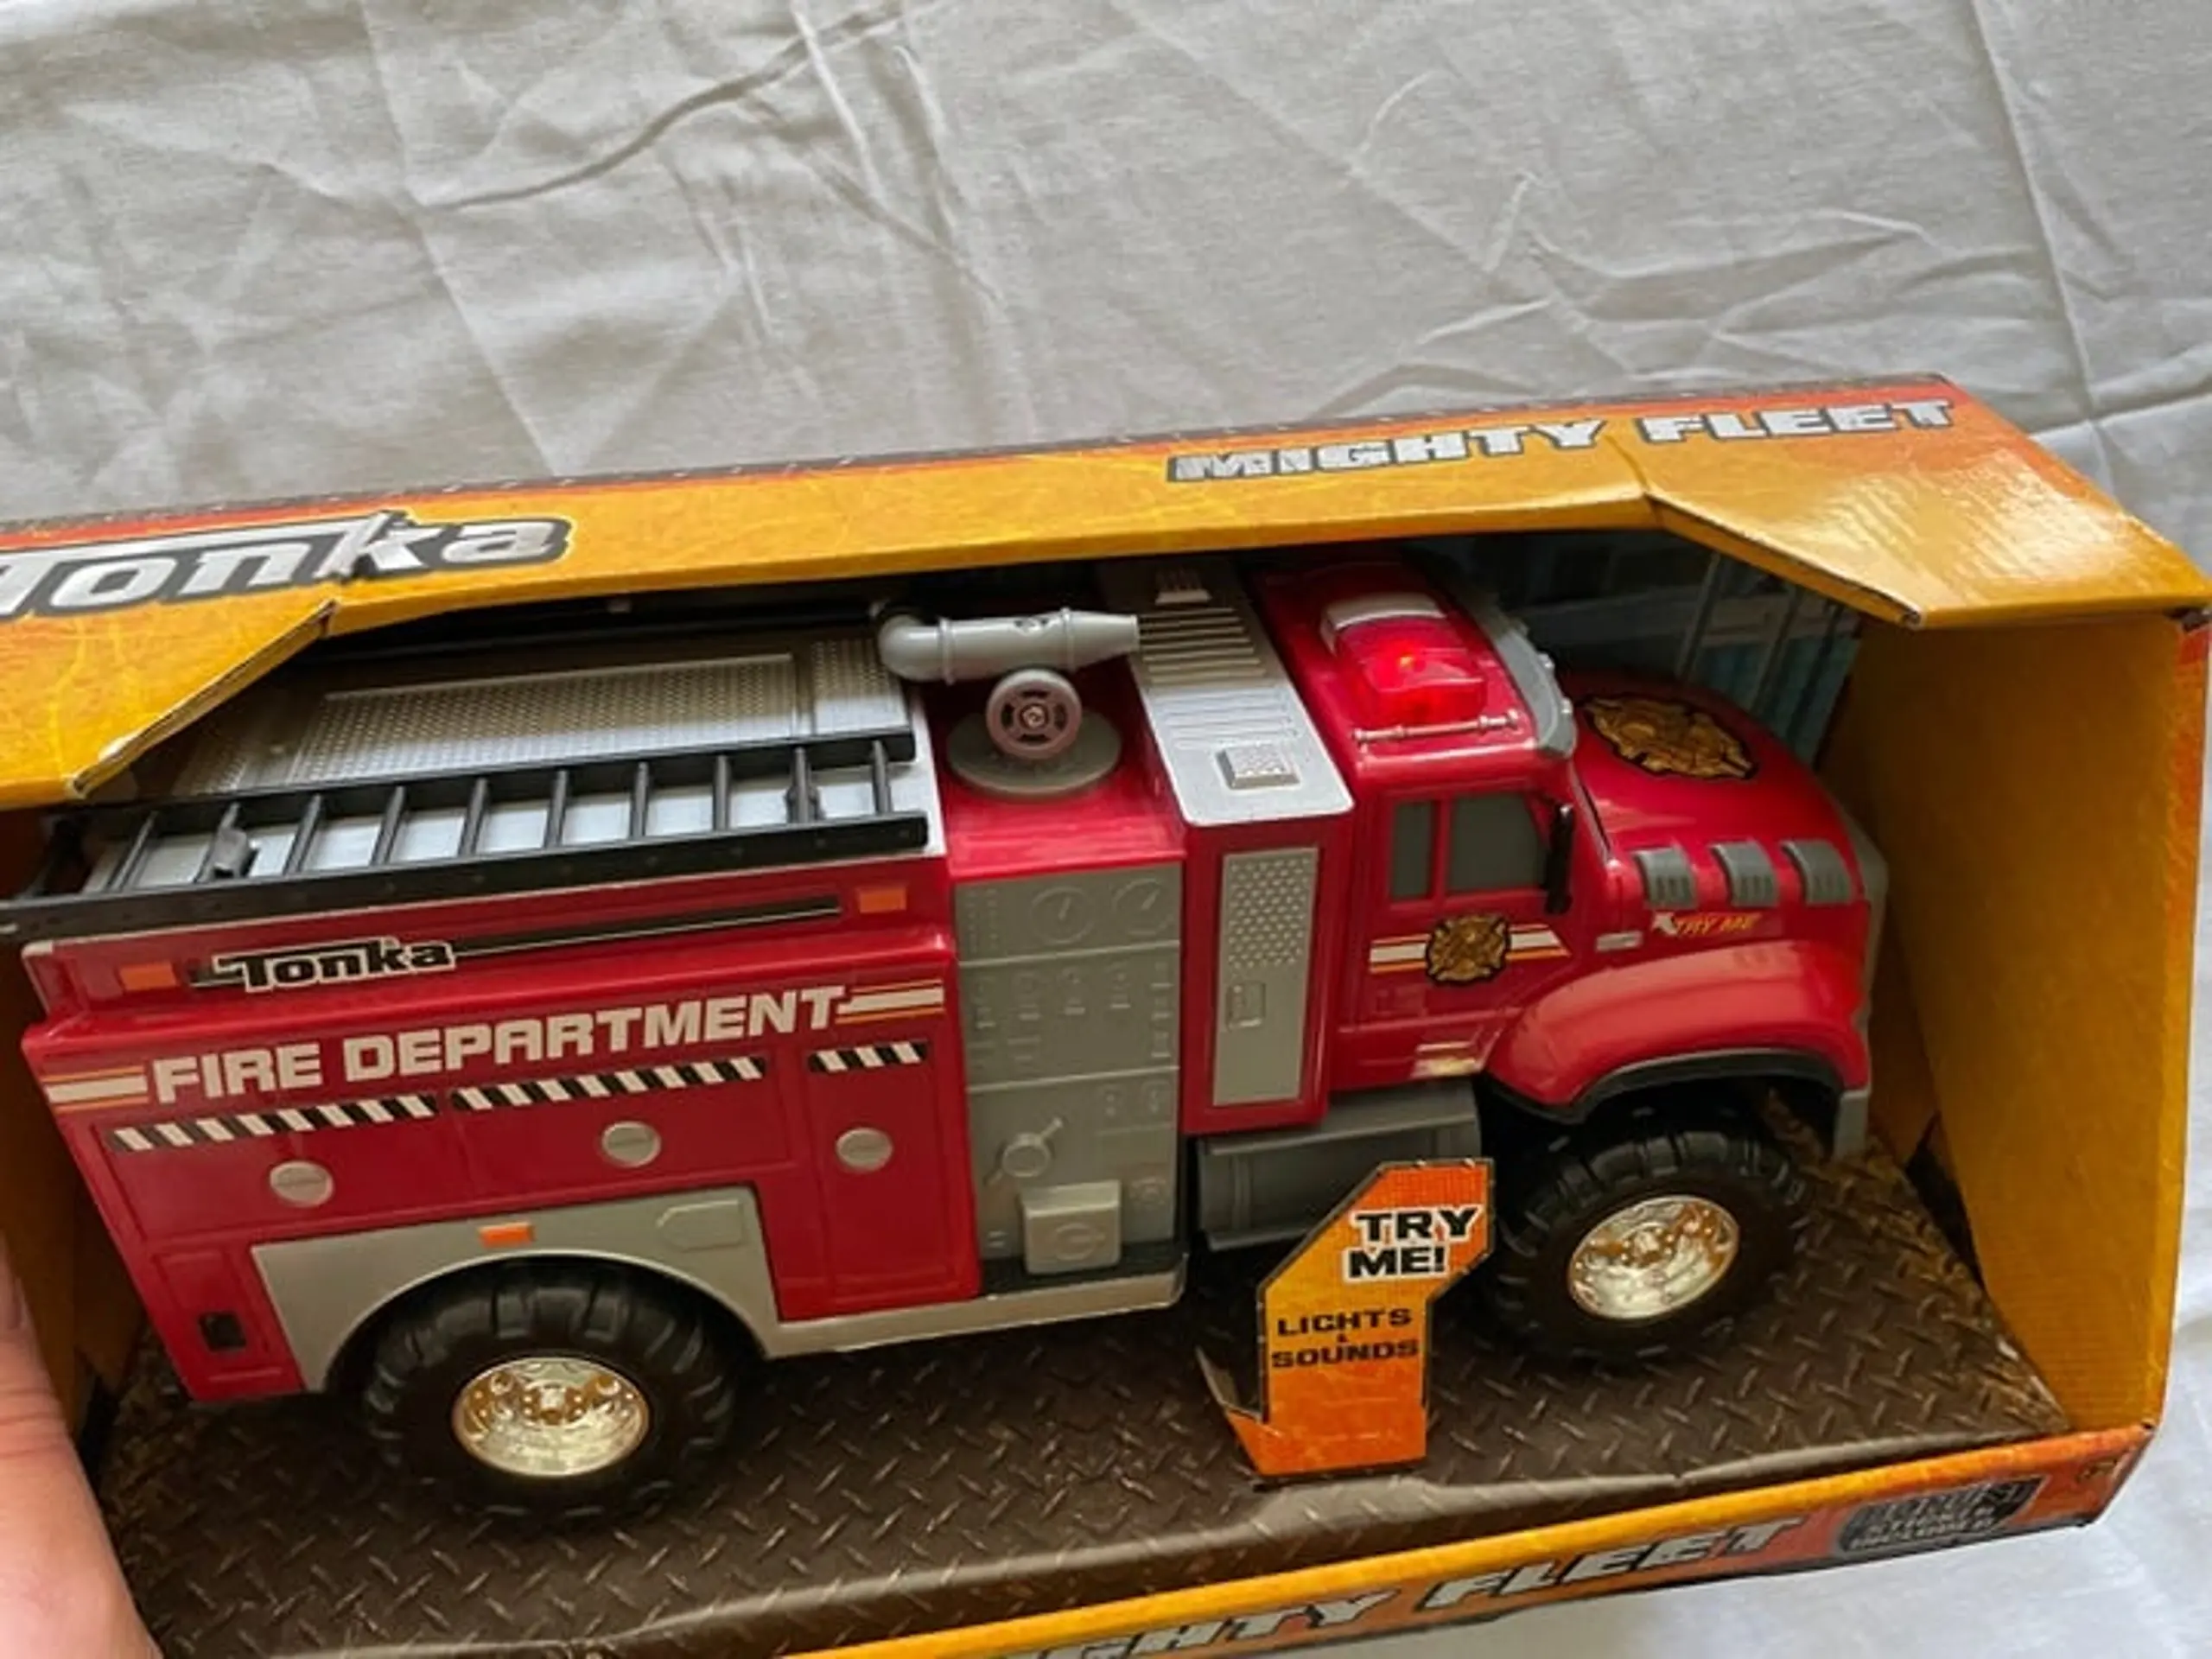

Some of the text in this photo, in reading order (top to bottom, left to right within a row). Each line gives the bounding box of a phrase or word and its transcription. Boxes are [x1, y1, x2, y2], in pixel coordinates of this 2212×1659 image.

[1167, 400, 1955, 480] MIGHTY FLEET
[213, 937, 455, 993] Tonka
[153, 985, 846, 1103] FIRE DEPARTMENT
[1354, 1207, 1480, 1243] TRY
[1346, 1246, 1448, 1280] ME!
[1277, 1307, 1413, 1337] LIGHTS
[1271, 1339, 1419, 1368] SOUNDS
[994, 1516, 1806, 1659] GHTY FLEET
